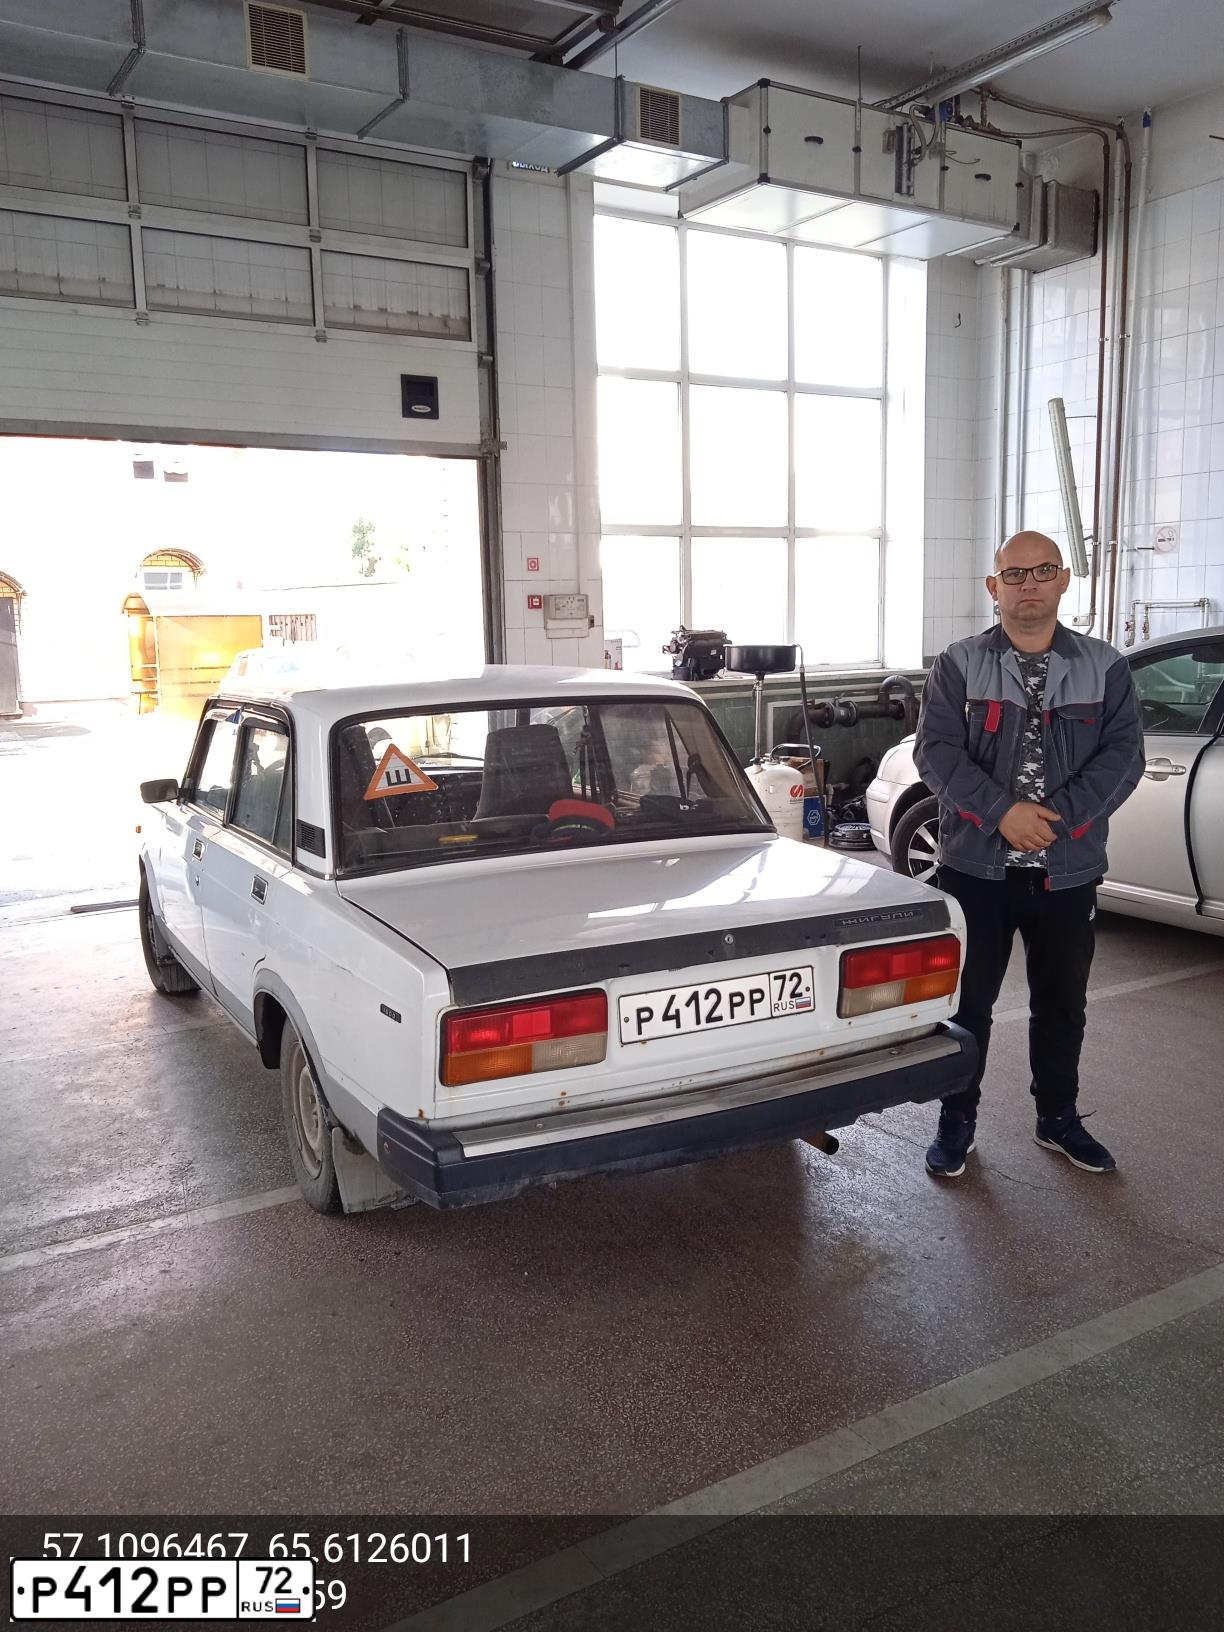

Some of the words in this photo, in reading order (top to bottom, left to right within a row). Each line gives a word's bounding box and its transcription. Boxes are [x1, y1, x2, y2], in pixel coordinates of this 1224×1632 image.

[385, 769, 412, 787] Ш
[773, 972, 804, 1001] 72
[773, 999, 795, 1013] RUS
